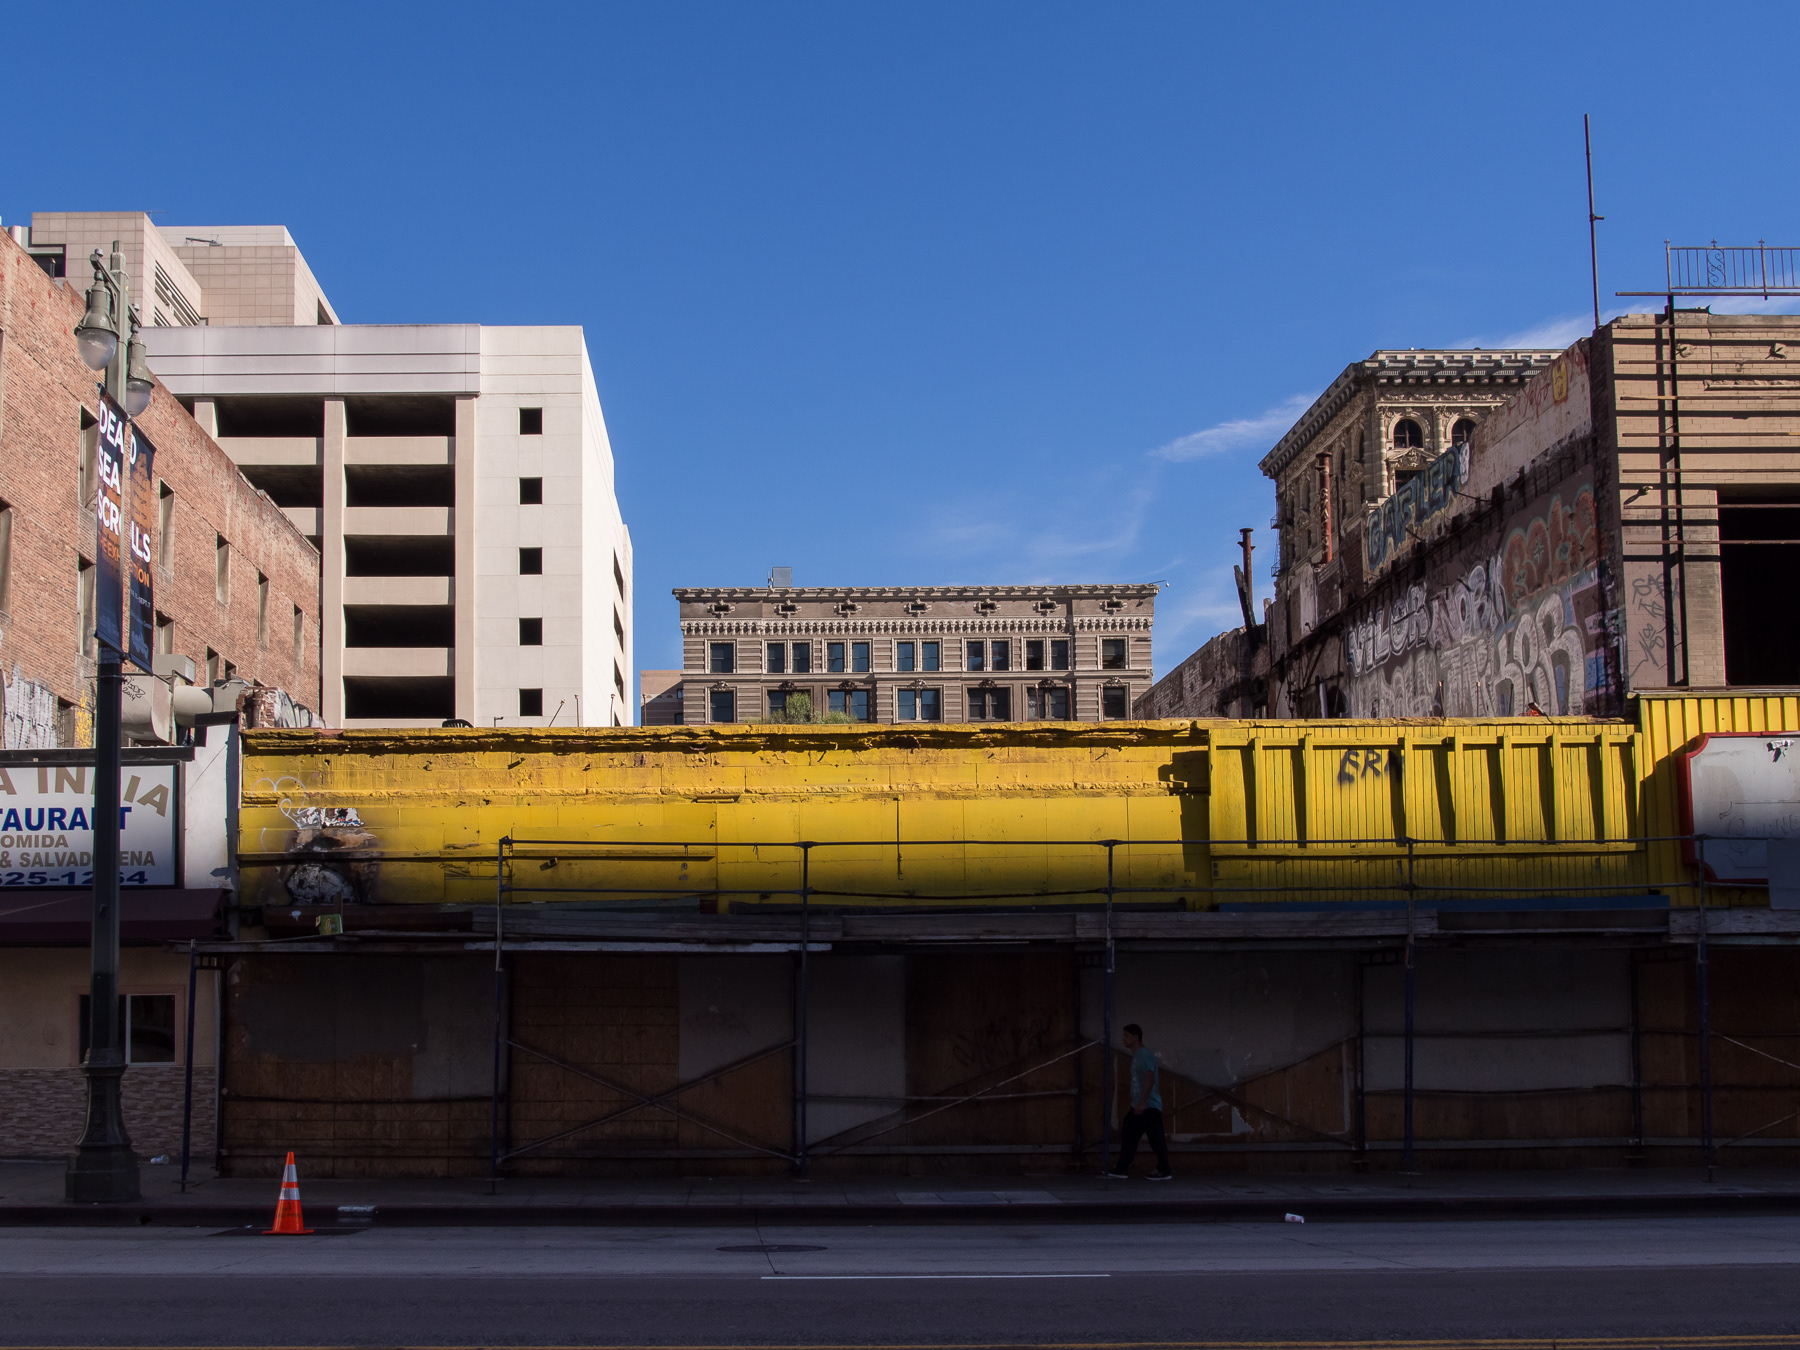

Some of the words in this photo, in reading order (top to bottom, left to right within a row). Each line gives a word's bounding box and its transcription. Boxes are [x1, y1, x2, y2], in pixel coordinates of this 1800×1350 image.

[98, 445, 120, 495] SEA
[97, 488, 151, 563] SCRLLS
[37, 766, 169, 818] INIA
[0, 807, 132, 831] AURAT
[19, 850, 156, 868] SALVADENA
